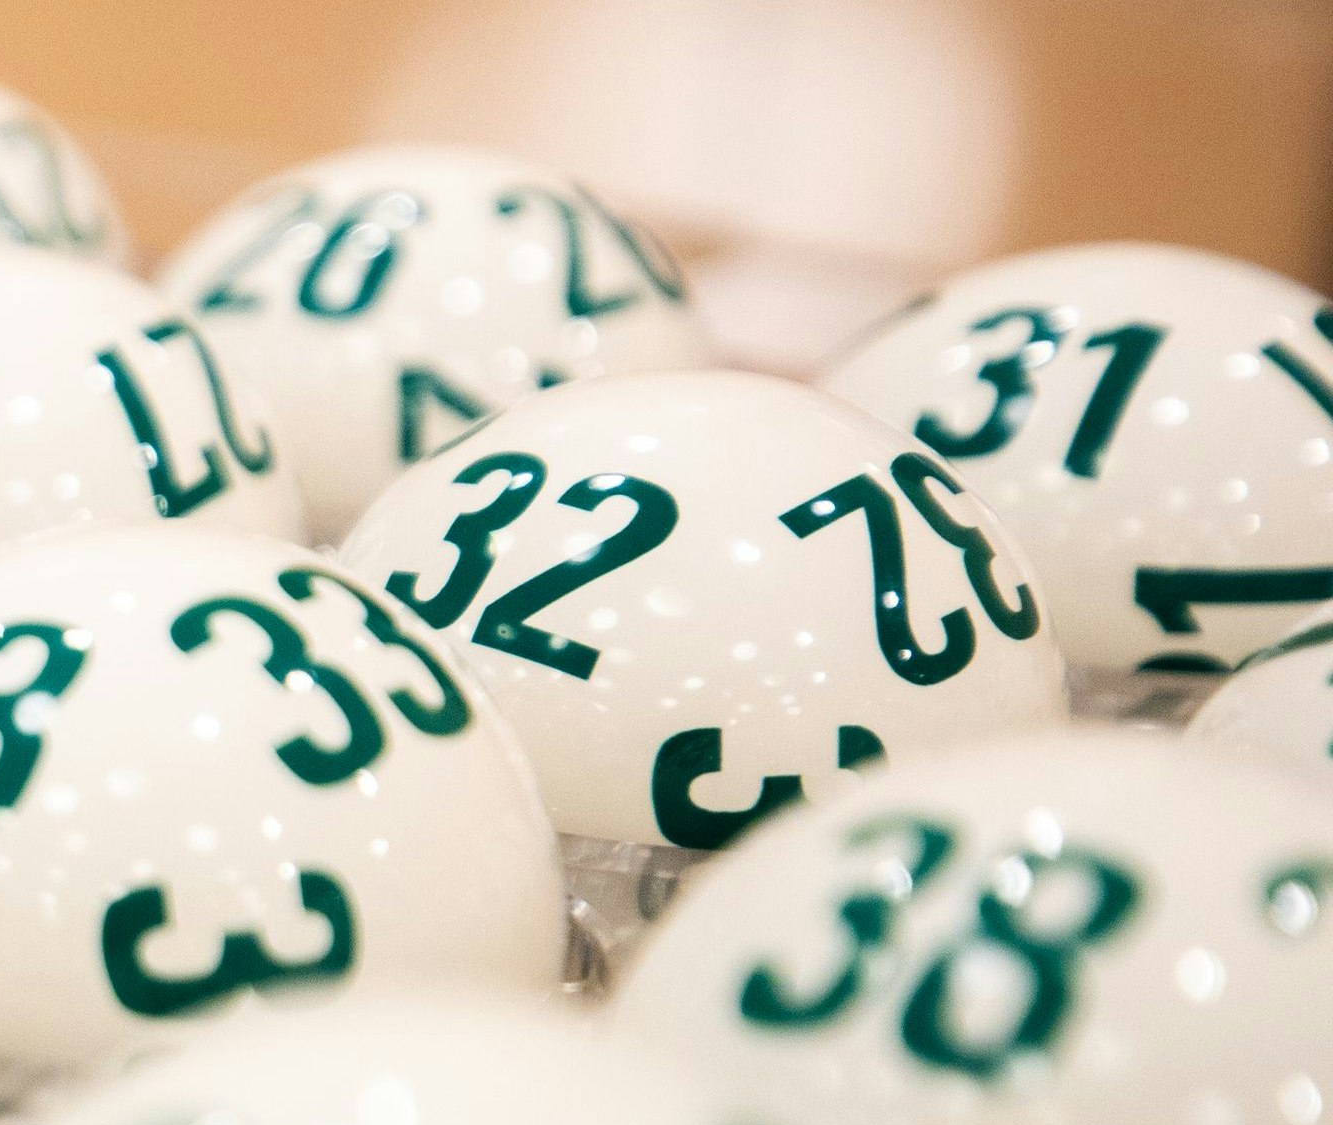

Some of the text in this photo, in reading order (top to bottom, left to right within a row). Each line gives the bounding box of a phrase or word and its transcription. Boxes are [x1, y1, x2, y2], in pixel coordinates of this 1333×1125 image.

[911, 305, 1175, 482] 31
[167, 562, 478, 790] 33
[381, 450, 681, 683] 32
[773, 450, 1045, 688] 32
[733, 808, 1153, 1080] 38
